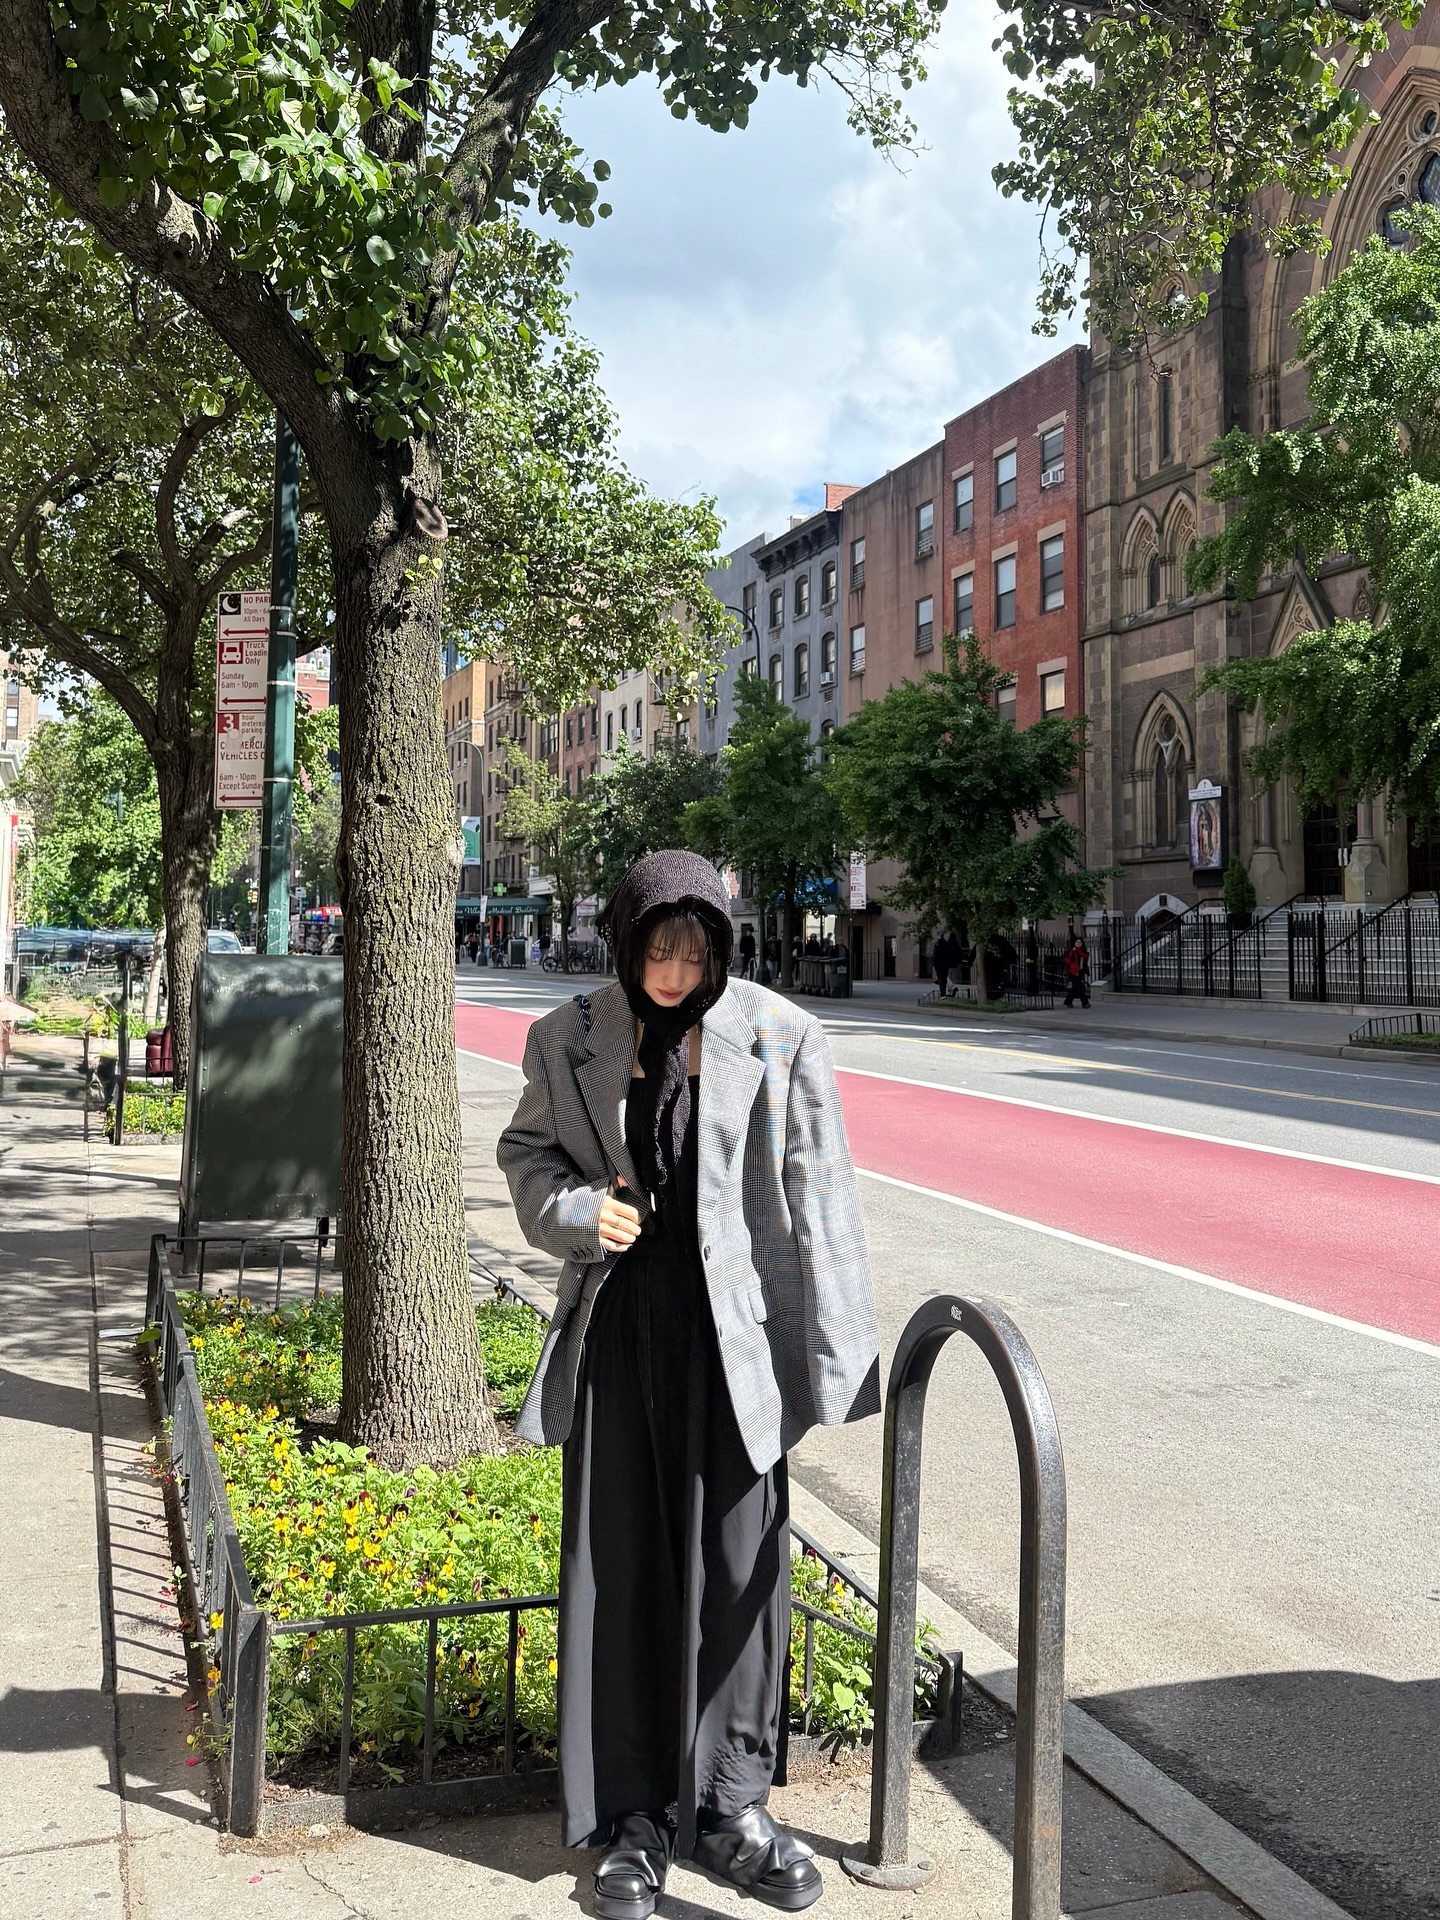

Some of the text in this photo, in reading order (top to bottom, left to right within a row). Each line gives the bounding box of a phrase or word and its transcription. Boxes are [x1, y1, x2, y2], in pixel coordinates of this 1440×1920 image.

[244, 596, 254, 604] NO
[221, 672, 245, 680] Sunday
[242, 681, 258, 689] 10pm
[223, 714, 235, 732] 3
[220, 752, 259, 760] VEHICLES
[240, 773, 256, 781] 10pm
